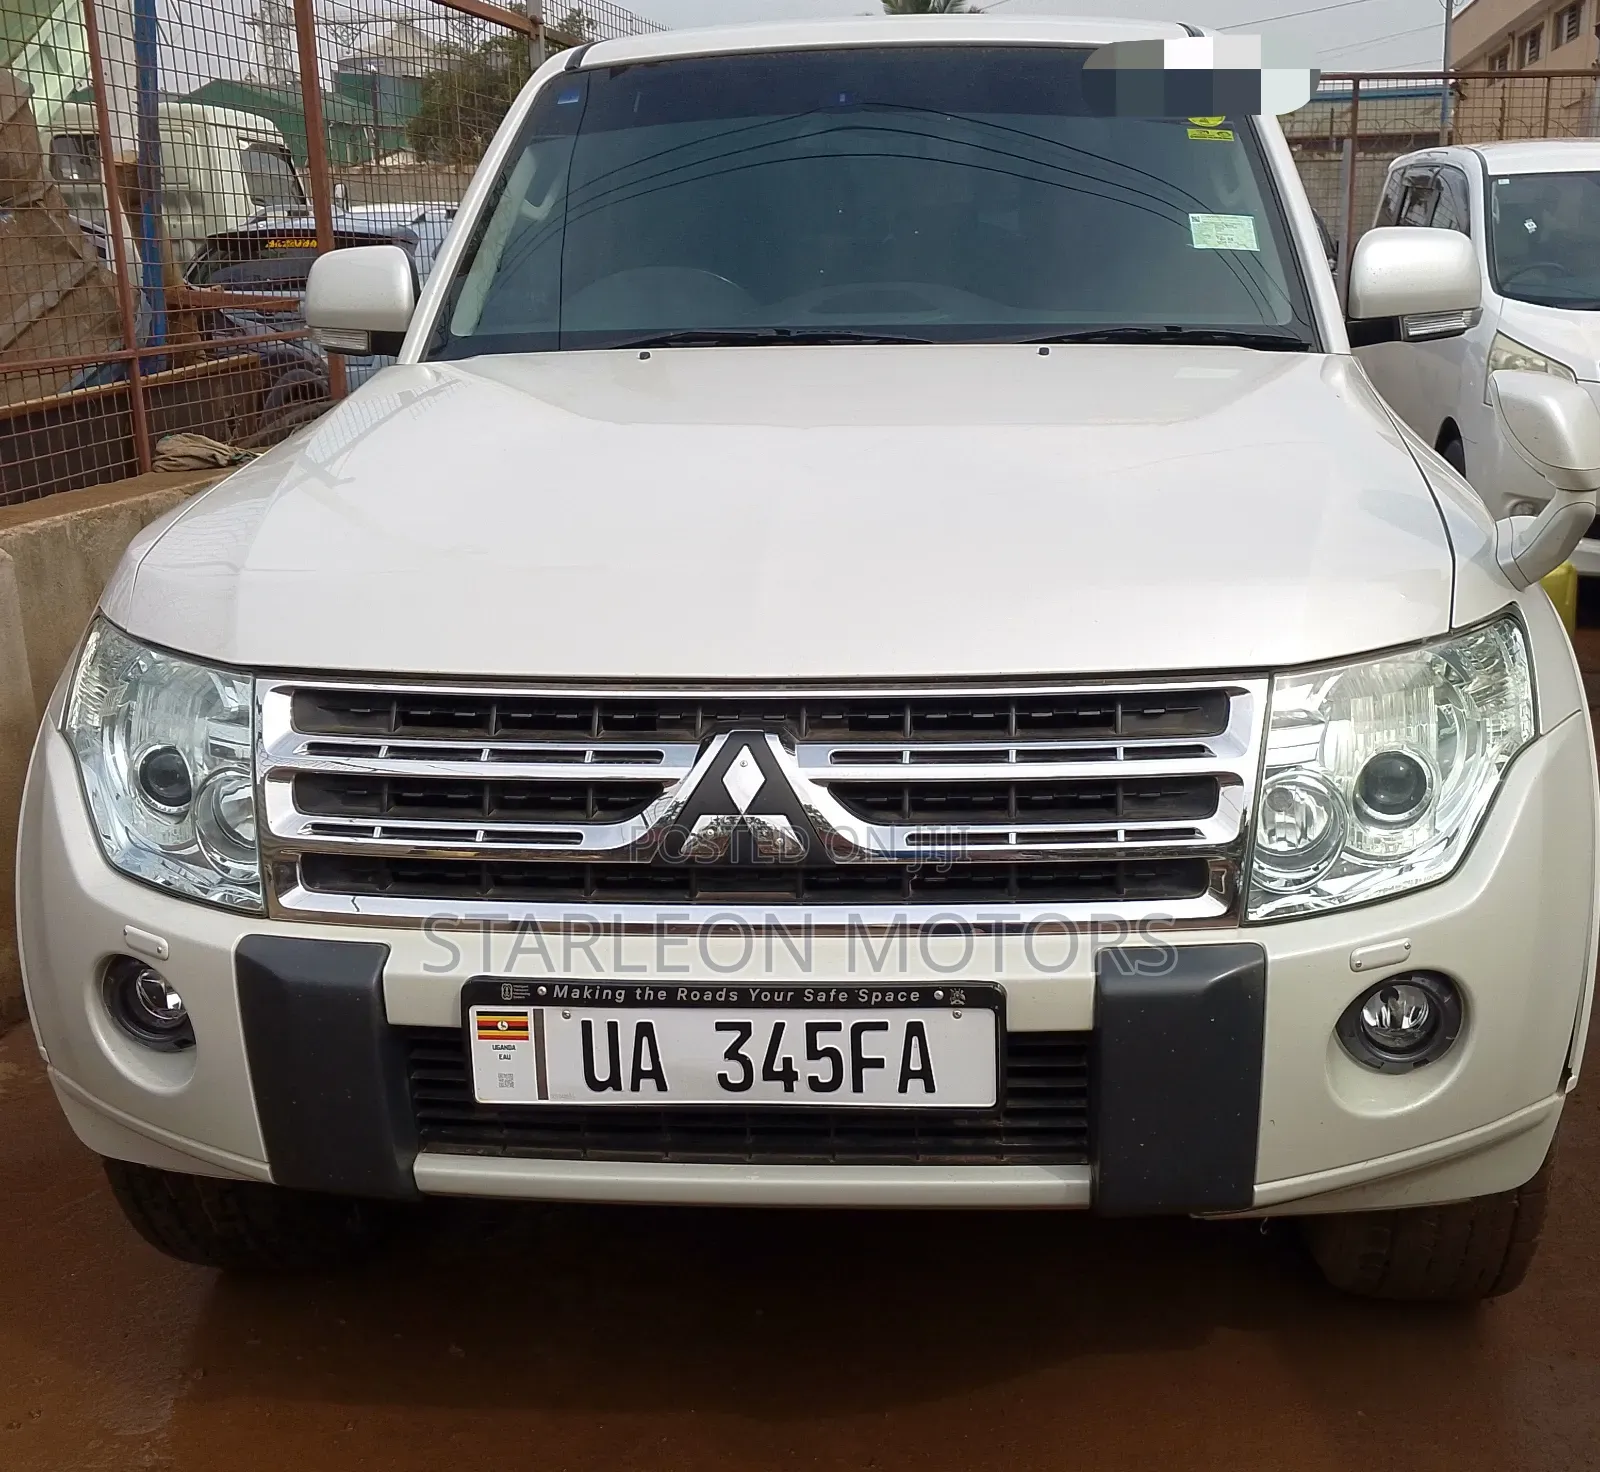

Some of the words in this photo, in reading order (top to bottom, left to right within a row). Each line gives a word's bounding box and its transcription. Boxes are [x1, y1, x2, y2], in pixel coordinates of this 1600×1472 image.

[553, 984, 626, 1002] Making
[635, 987, 667, 1001] the
[677, 988, 739, 1001] Roads
[749, 988, 794, 1002] Your
[803, 988, 848, 1002] Safe
[857, 988, 920, 1005] Space
[581, 1019, 669, 1092] UA
[714, 1020, 937, 1093] 345FA
